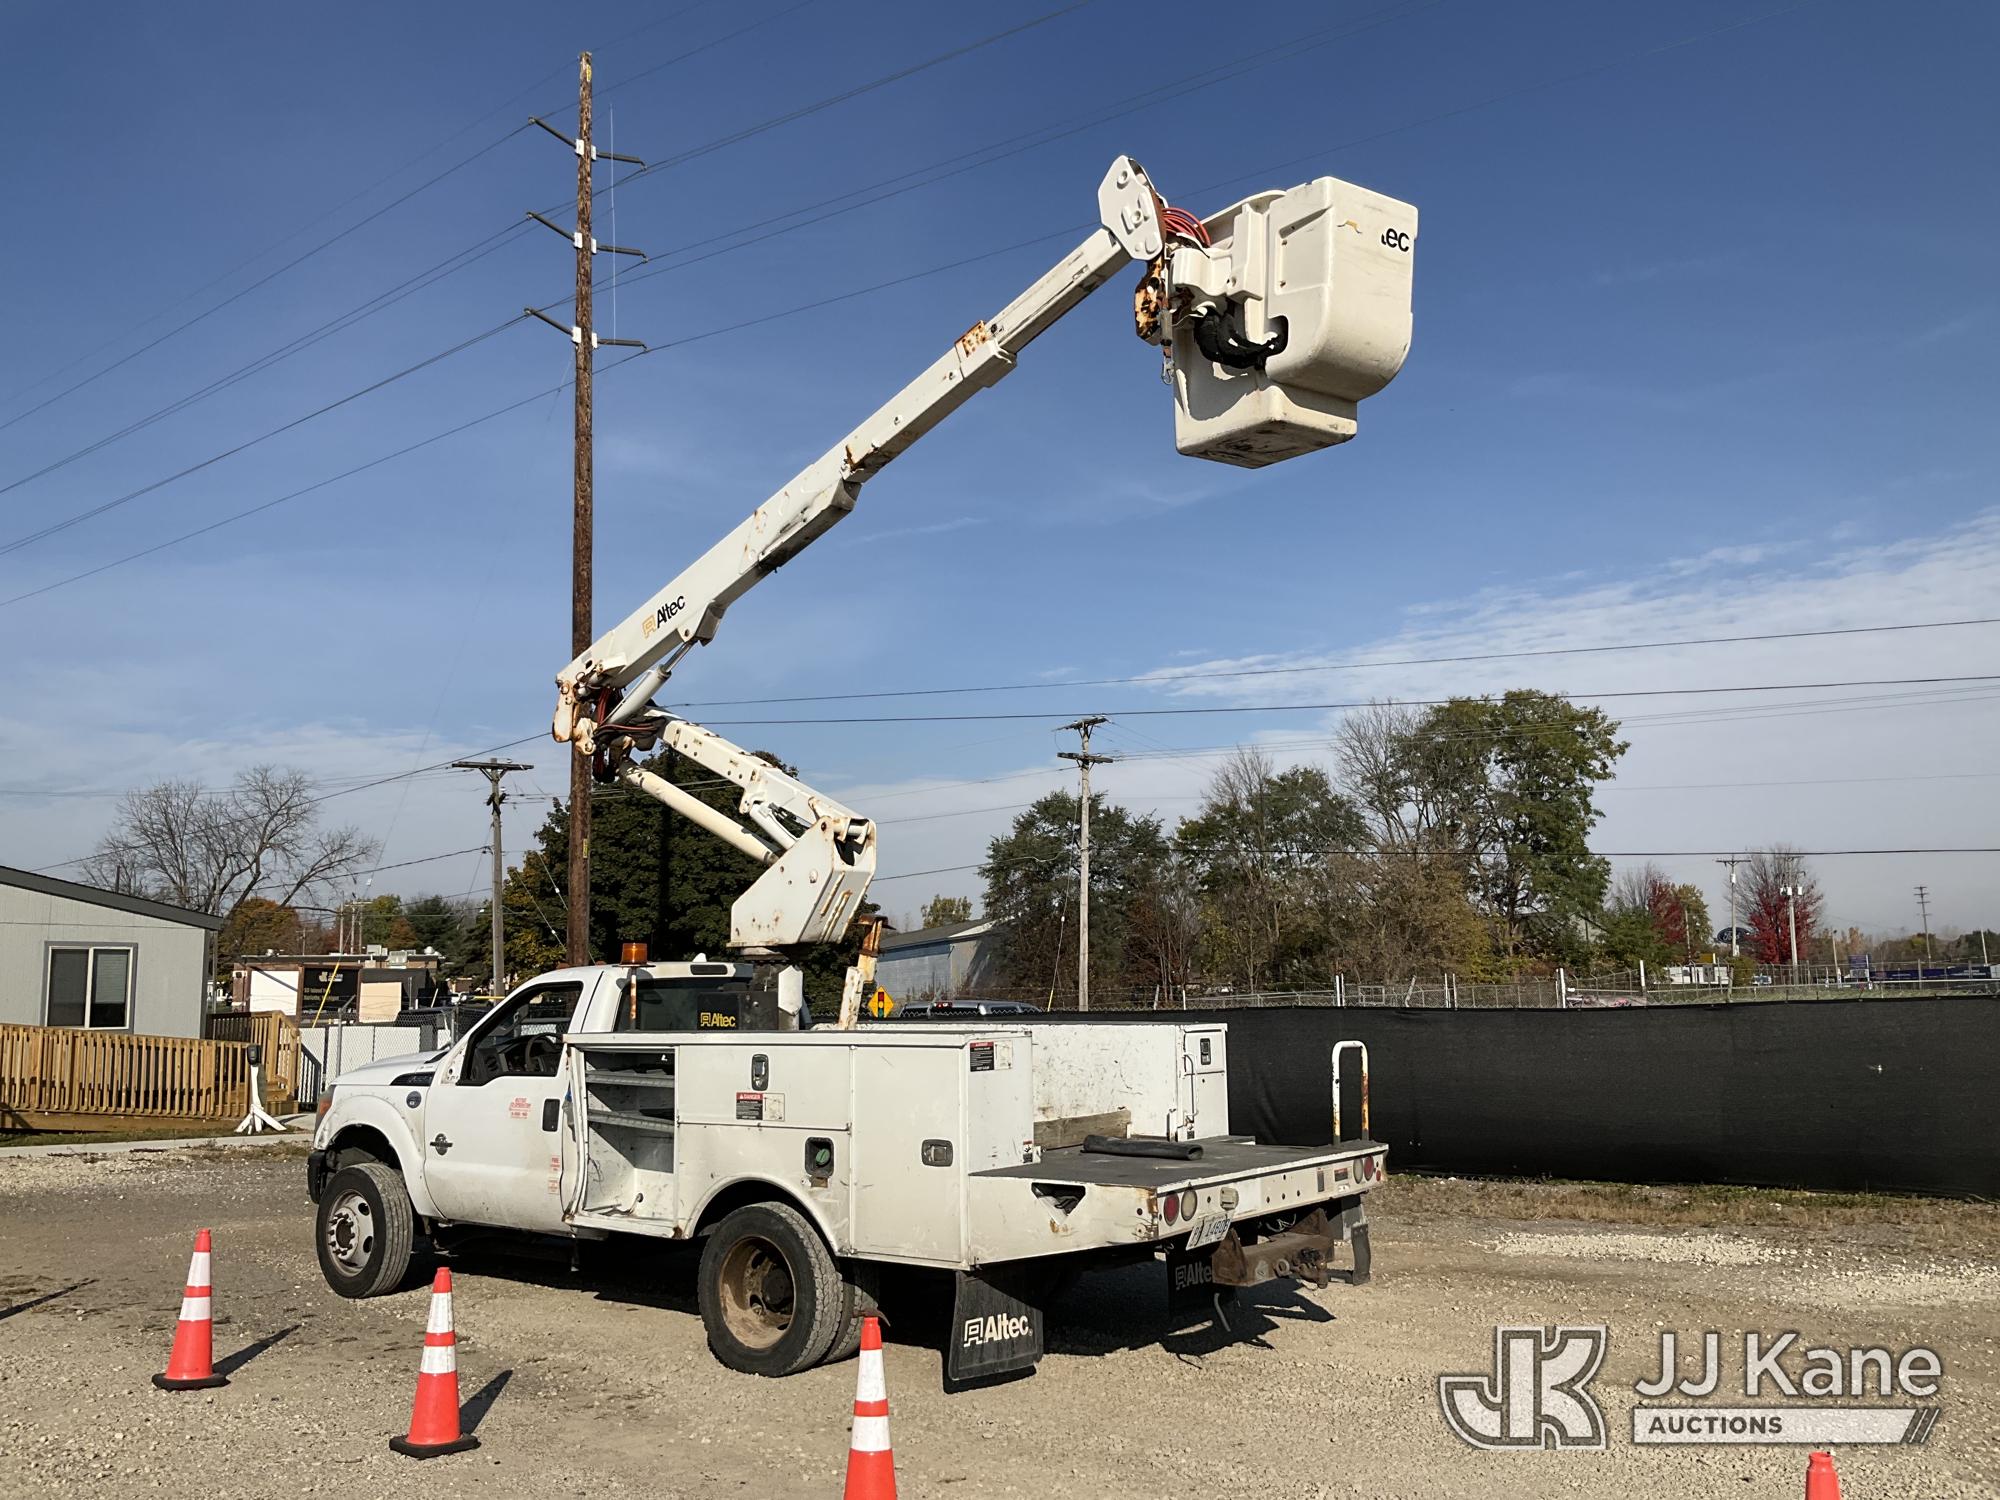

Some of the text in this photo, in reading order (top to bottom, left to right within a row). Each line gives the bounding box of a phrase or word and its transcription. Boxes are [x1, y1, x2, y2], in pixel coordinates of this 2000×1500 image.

[657, 595, 686, 629] Altec
[711, 1012, 736, 1027] Altec
[1186, 1261, 1212, 1287] Alte
[984, 1312, 1029, 1343] Altec
